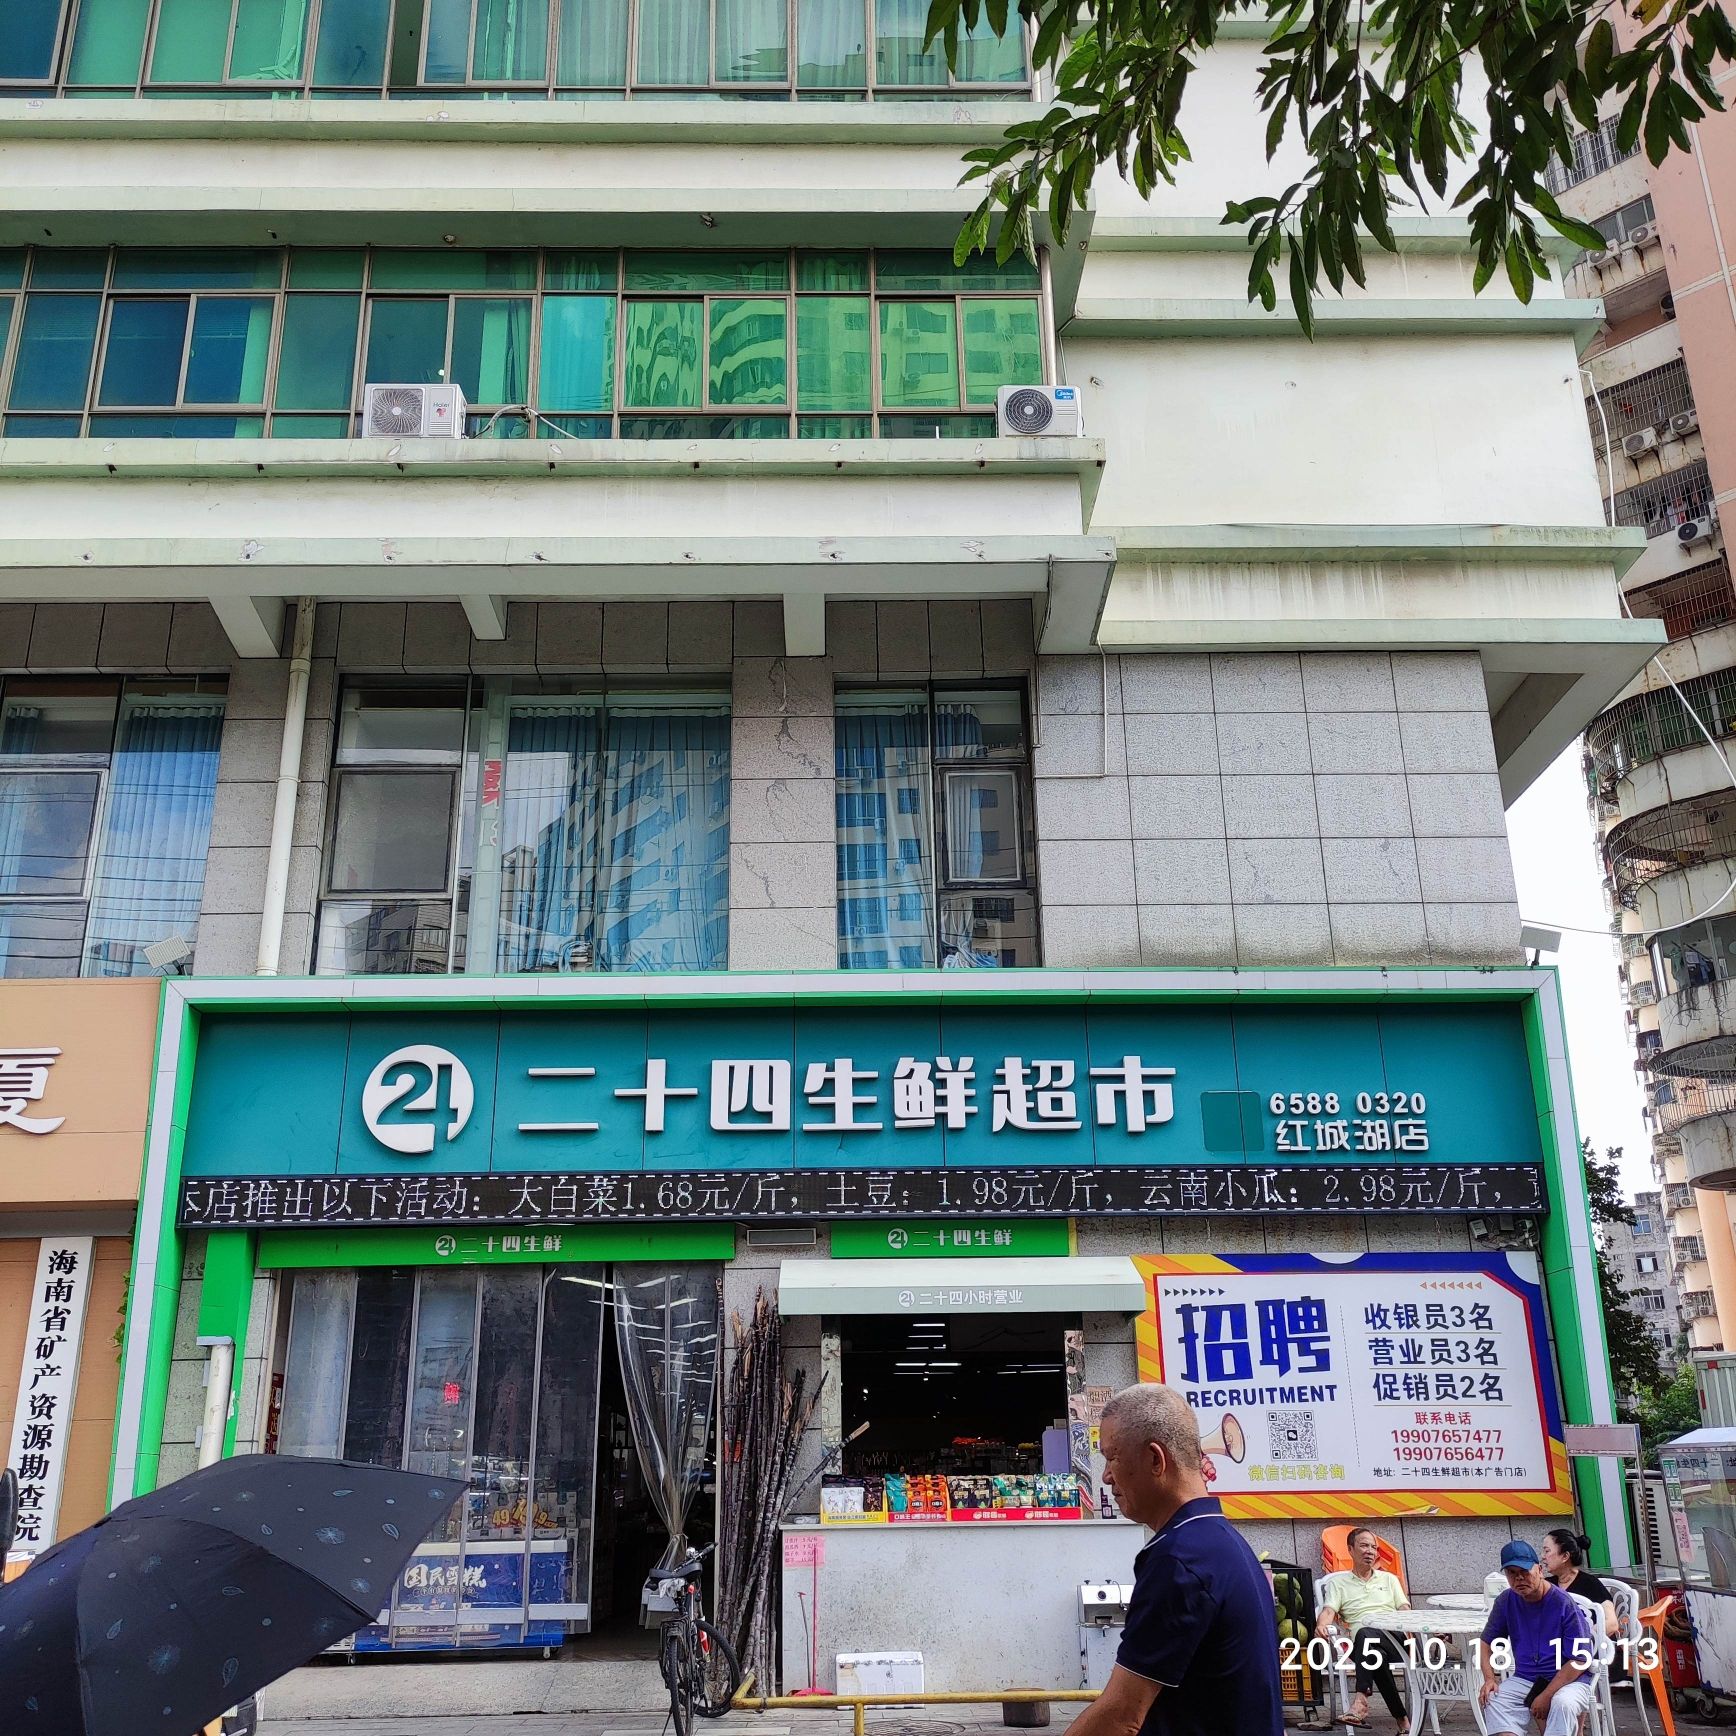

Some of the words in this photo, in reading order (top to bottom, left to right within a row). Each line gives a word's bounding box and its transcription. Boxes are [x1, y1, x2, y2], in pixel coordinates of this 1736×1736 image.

[518, 1055, 1176, 1133] 二十四生鲜超市
[1270, 1092, 1340, 1114] 6588
[1356, 1092, 1426, 1114] 0320
[1276, 1118, 1429, 1151] 红城湖店
[461, 1234, 562, 1253] 二十四生鲜
[913, 1229, 1012, 1246] 二十四生鲜
[919, 1289, 1023, 1305] 二十四小时营业
[1364, 1302, 1493, 1331] 收银员3名
[1175, 1296, 1331, 1384] 招聘
[1368, 1337, 1498, 1366] 营业员3名
[15, 1249, 78, 1542] 海南省矿产资源勘查院
[1186, 1384, 1338, 1408] RECRUITMENT
[1372, 1372, 1503, 1402] 促销员2名
[1414, 1412, 1472, 1426] 联系电话
[1391, 1429, 1502, 1444] 19907657477
[1393, 1446, 1504, 1461] 19907656477
[1248, 1464, 1345, 1481] 微信扫码咨询
